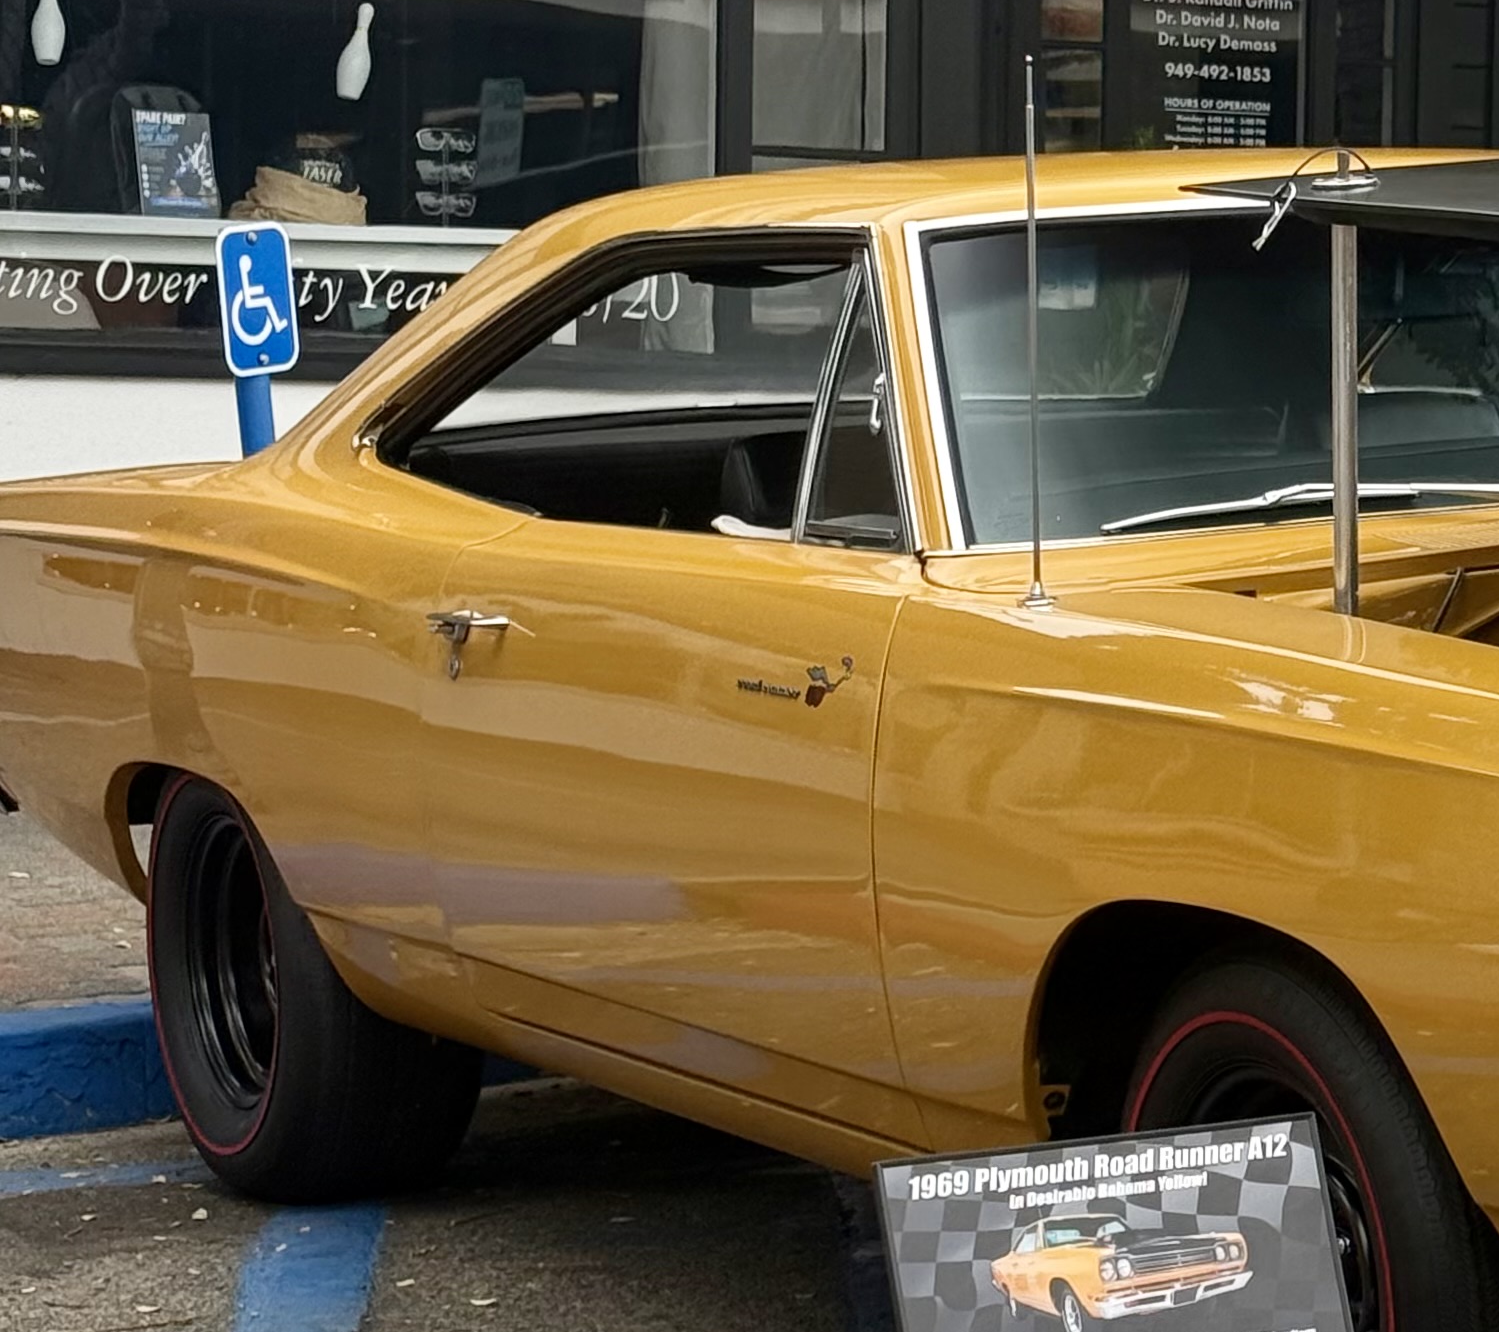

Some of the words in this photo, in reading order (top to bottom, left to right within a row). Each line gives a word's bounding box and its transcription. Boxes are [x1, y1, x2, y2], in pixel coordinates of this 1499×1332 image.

[1156, 9, 1177, 26] Dr.
[1181, 11, 1225, 28] David
[1227, 14, 1240, 30] J.
[1243, 15, 1280, 31] Nota
[1158, 31, 1179, 47] Dr.
[1183, 33, 1216, 53] Lucy
[1220, 34, 1278, 53] Demoss
[1164, 62, 1272, 83] 949-492-1853
[1164, 97, 1199, 108] HOURS
[1200, 99, 1214, 109] OF
[1216, 100, 1271, 112] OPERATION
[96, 255, 208, 304] Over
[907, 1169, 969, 1200] 1969
[973, 1157, 1089, 1193] Plymouth
[1093, 1151, 1154, 1178] Road
[1157, 1141, 1244, 1170] Runner
[1247, 1131, 1288, 1160] A12
[1009, 1194, 1025, 1210] In
[1026, 1186, 1096, 1208] Desirable
[1097, 1178, 1155, 1199] Bahama
[1157, 1171, 1207, 1194] Yellow!
